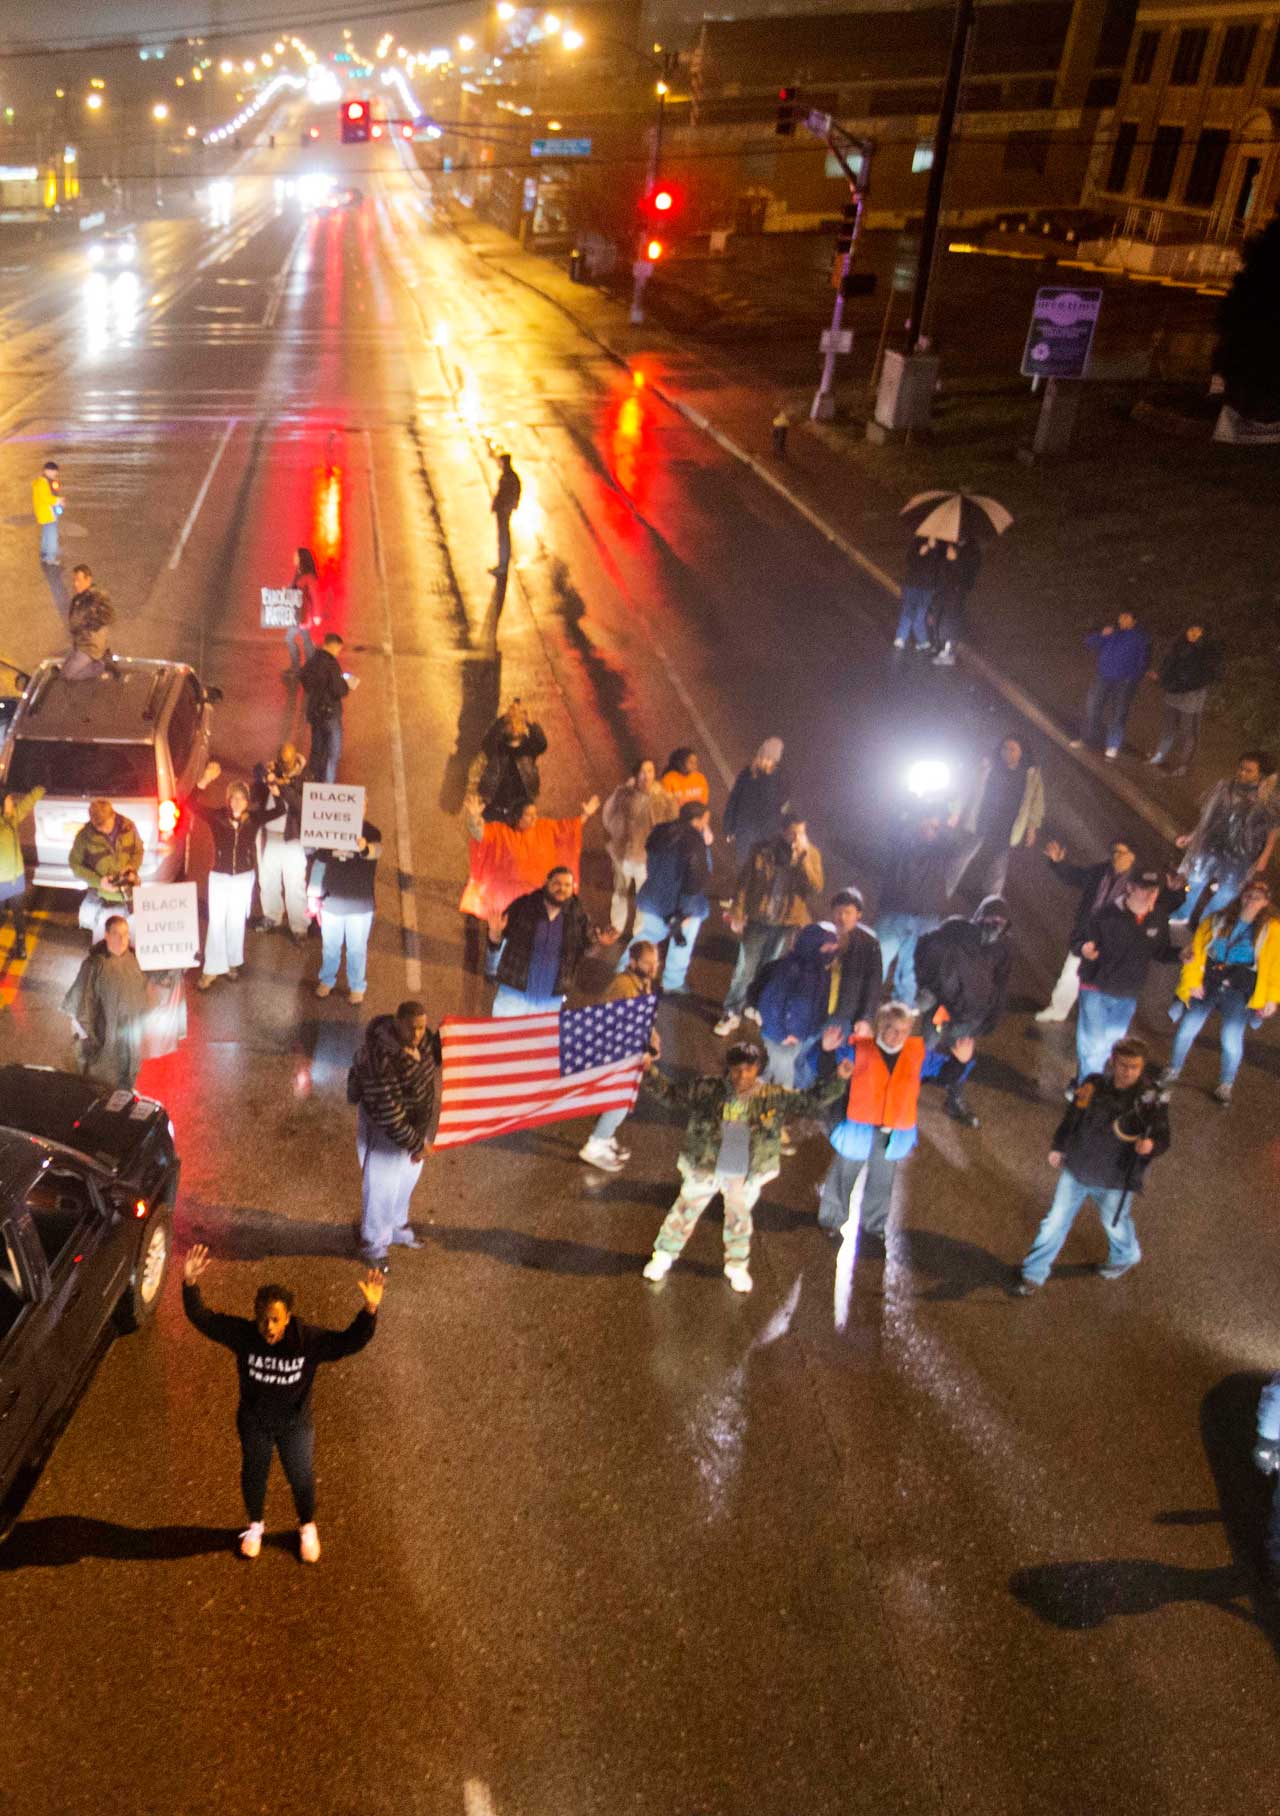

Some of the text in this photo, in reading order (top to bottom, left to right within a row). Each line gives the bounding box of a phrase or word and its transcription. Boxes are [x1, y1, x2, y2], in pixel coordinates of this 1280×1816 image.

[309, 791, 356, 804] BLACK
[313, 811, 351, 822] LIVES
[304, 829, 357, 840] MATTER
[142, 899, 188, 911] BLACK
[147, 921, 184, 932] LIVES
[140, 942, 193, 953] MATTER
[248, 1354, 305, 1372] RACIALLY
